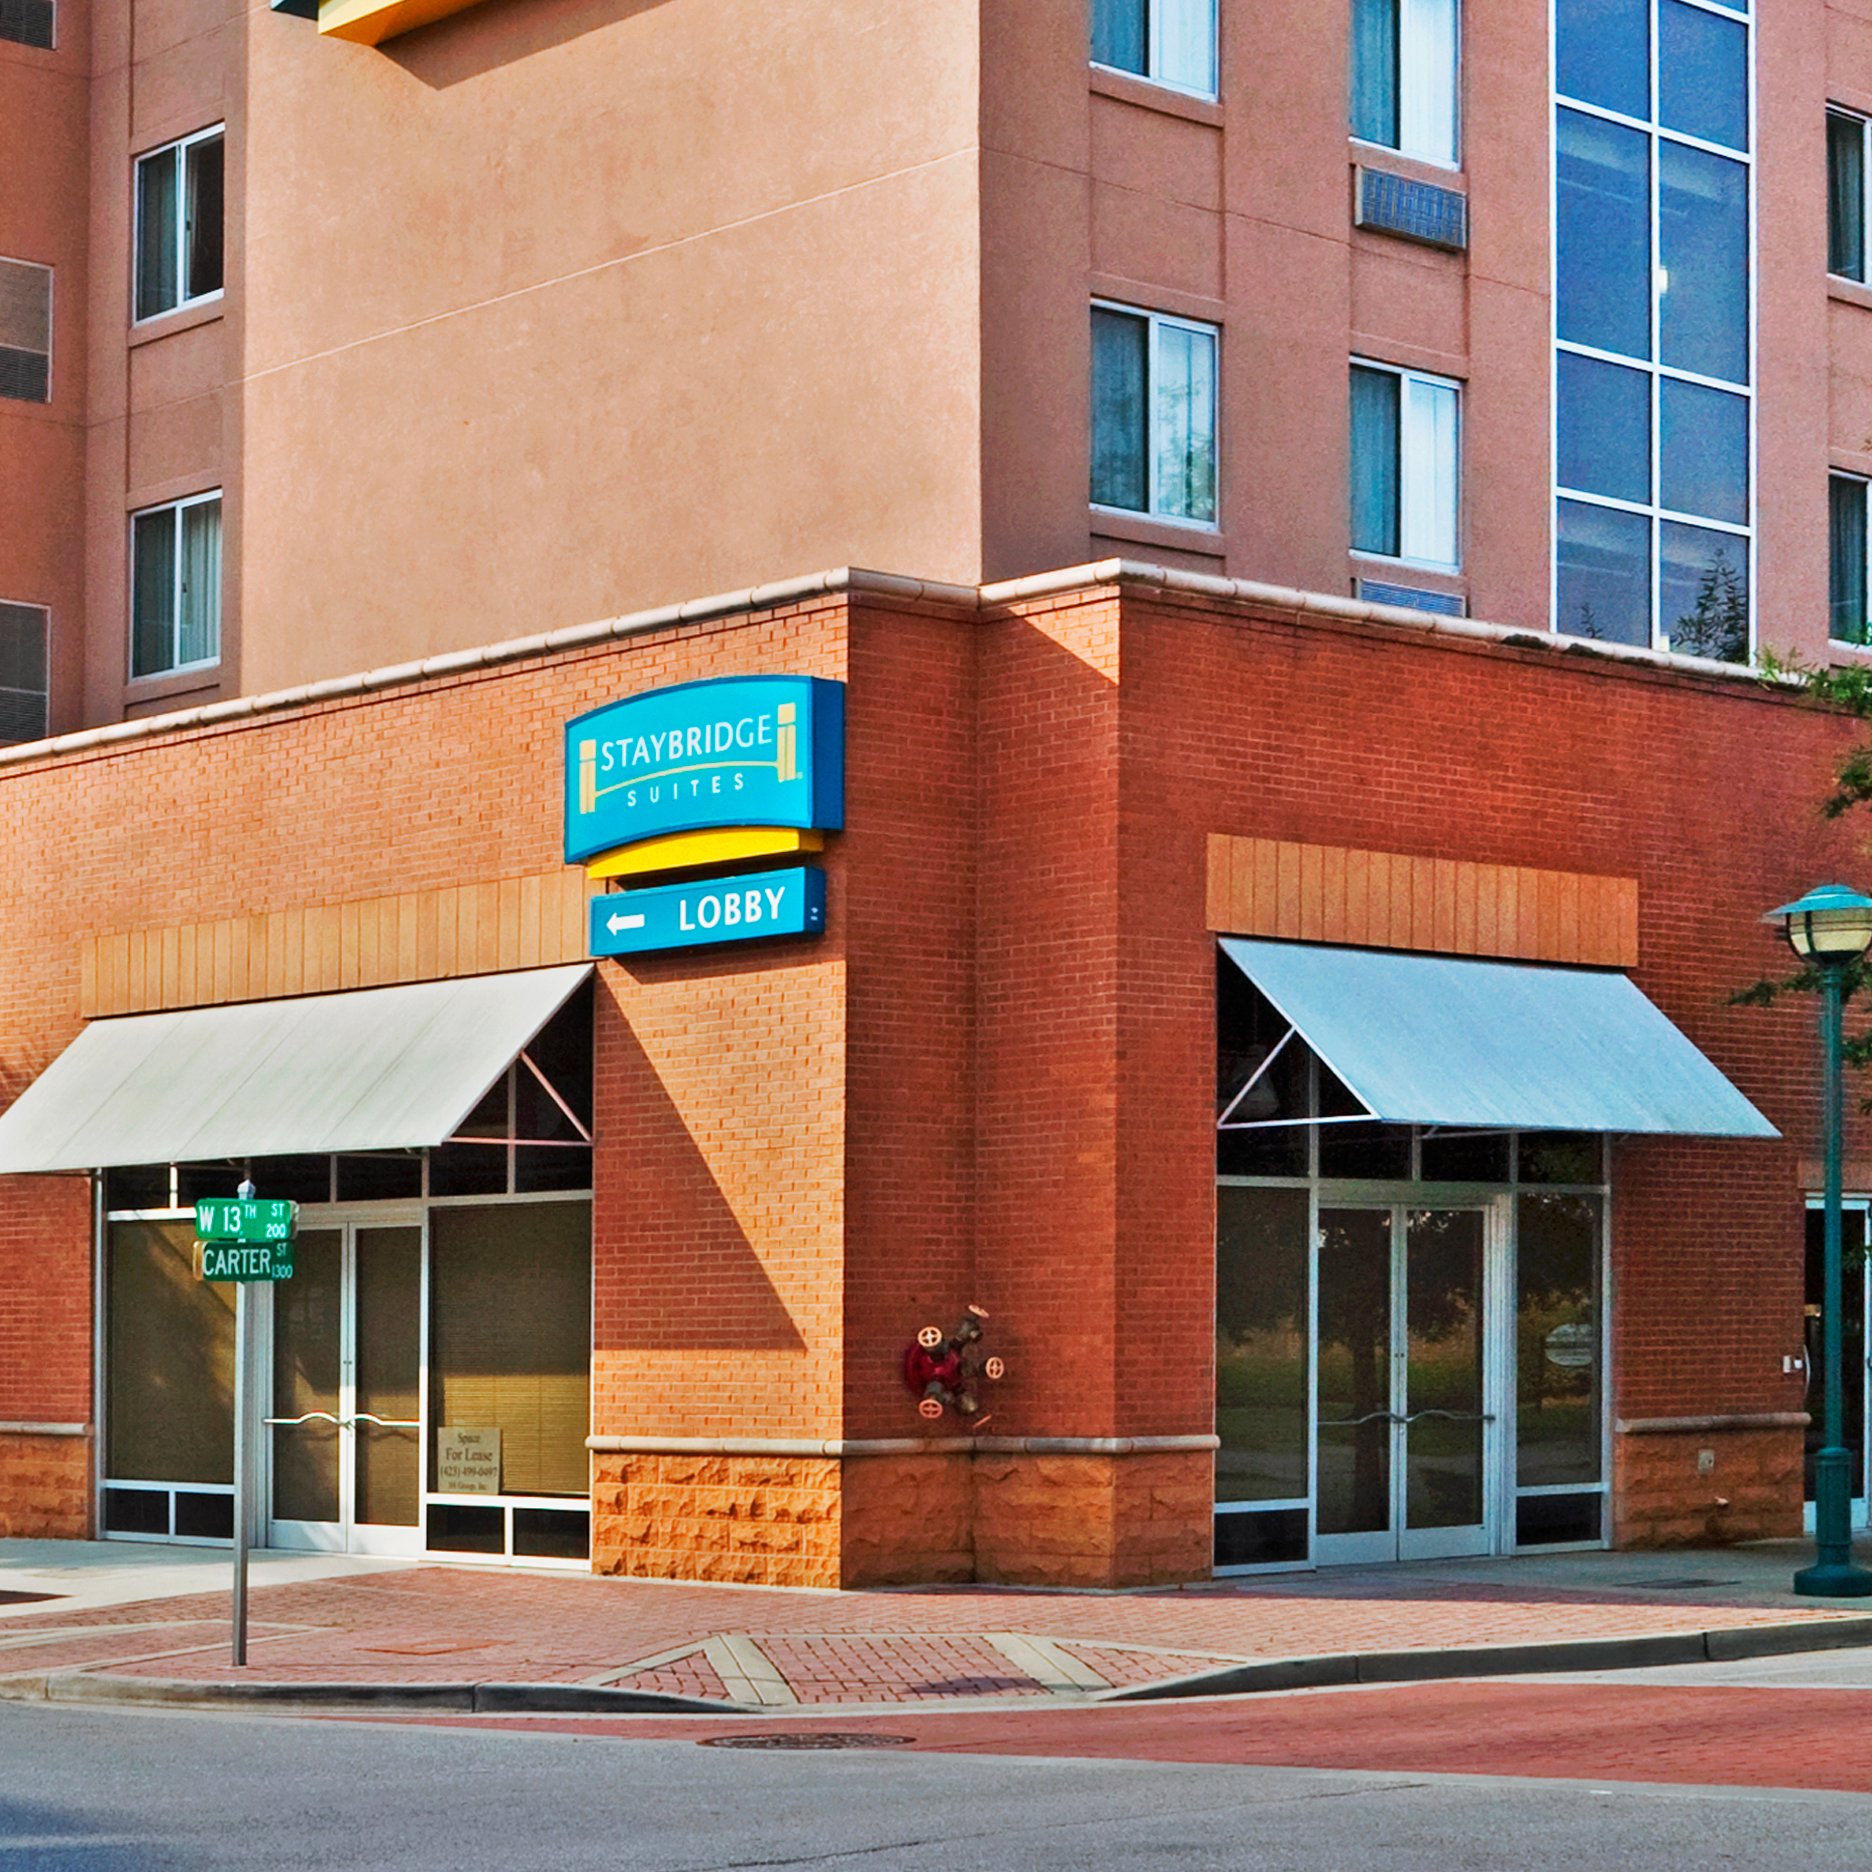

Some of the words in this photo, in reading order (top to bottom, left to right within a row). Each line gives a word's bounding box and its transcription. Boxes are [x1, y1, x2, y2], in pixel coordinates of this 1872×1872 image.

[601, 714, 773, 771] STAYBRIDGE
[627, 773, 745, 807] SUITES
[679, 886, 786, 932] LOBBY
[199, 1206, 215, 1232] W
[271, 1203, 286, 1218] ST
[266, 1224, 286, 1238] 200
[203, 1249, 271, 1275] CARTER
[276, 1243, 287, 1256] ST
[271, 1265, 293, 1278] 1300
[445, 1447, 463, 1461] For
[465, 1447, 493, 1462] Lease
